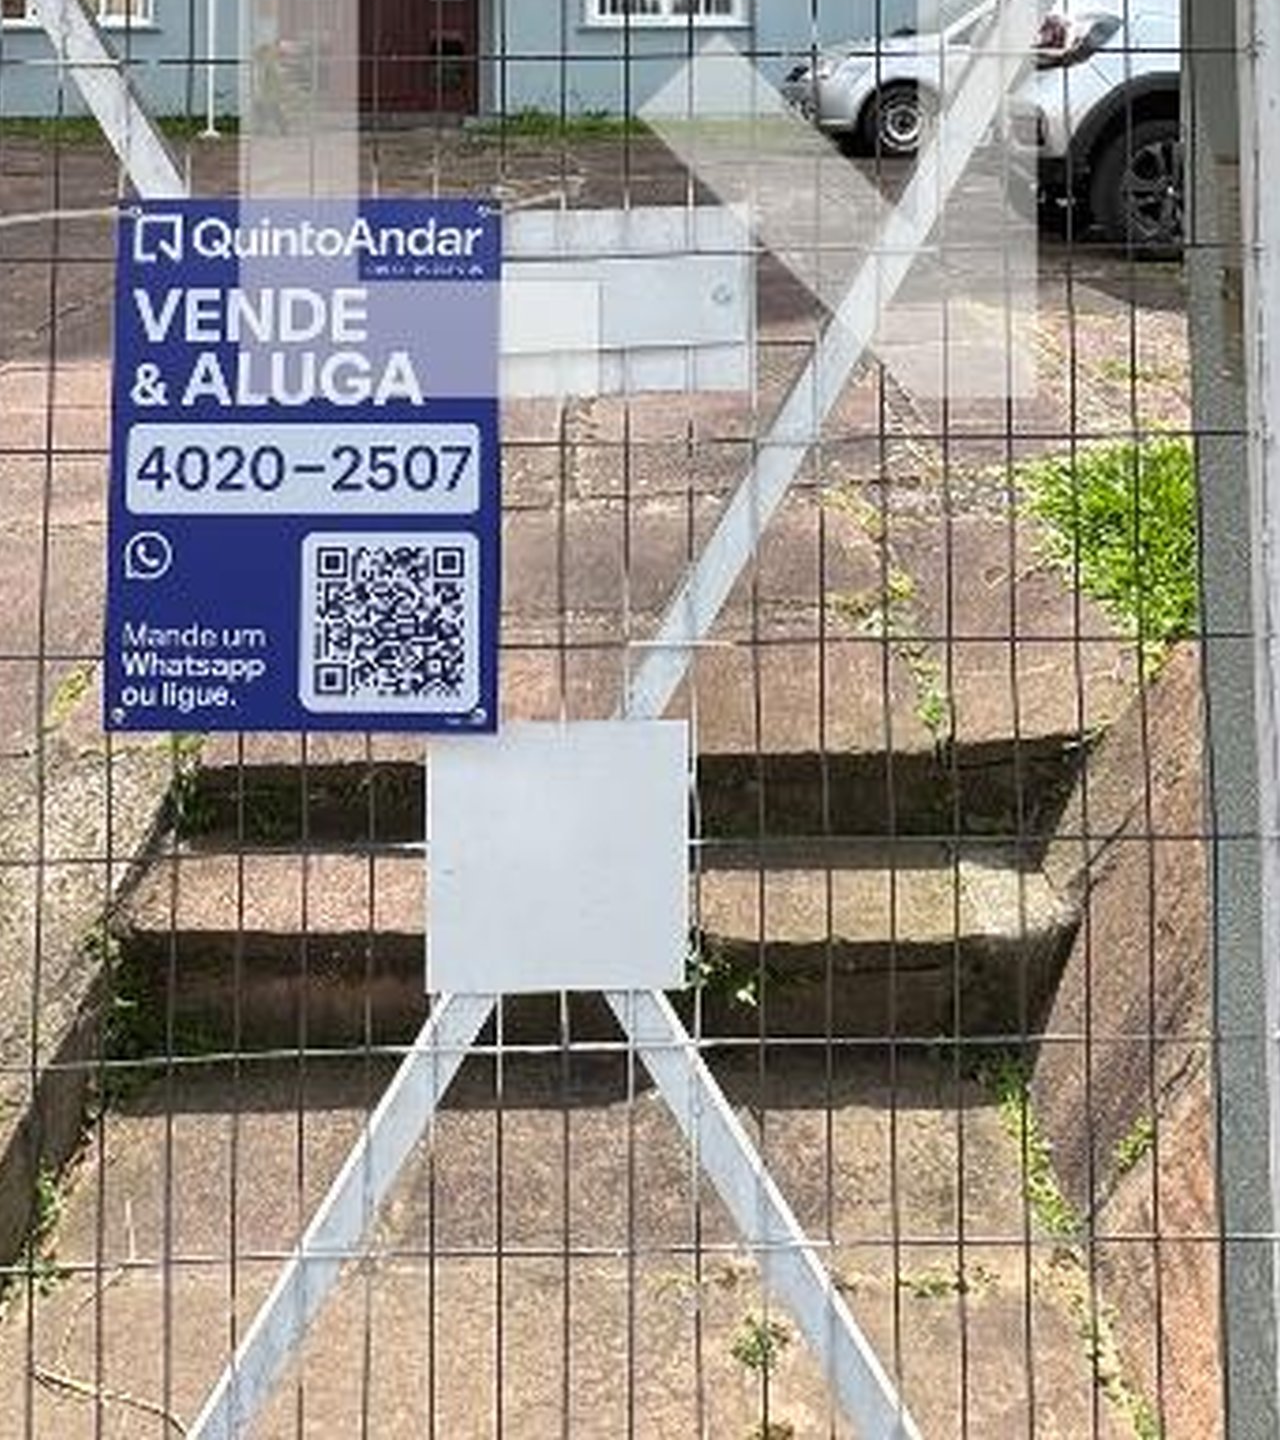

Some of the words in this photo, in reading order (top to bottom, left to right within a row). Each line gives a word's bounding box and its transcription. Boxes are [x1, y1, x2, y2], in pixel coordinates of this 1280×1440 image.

[192, 216, 483, 259] QuintoAndar
[133, 288, 368, 342] VENDE
[131, 364, 168, 406] &
[181, 352, 424, 406] ALUGA
[135, 445, 473, 492] 4020-2507
[122, 622, 217, 647] Mande
[222, 629, 266, 647] um
[121, 652, 266, 683] Whatsapp
[121, 685, 157, 706] ou
[162, 681, 236, 713] ligue.
